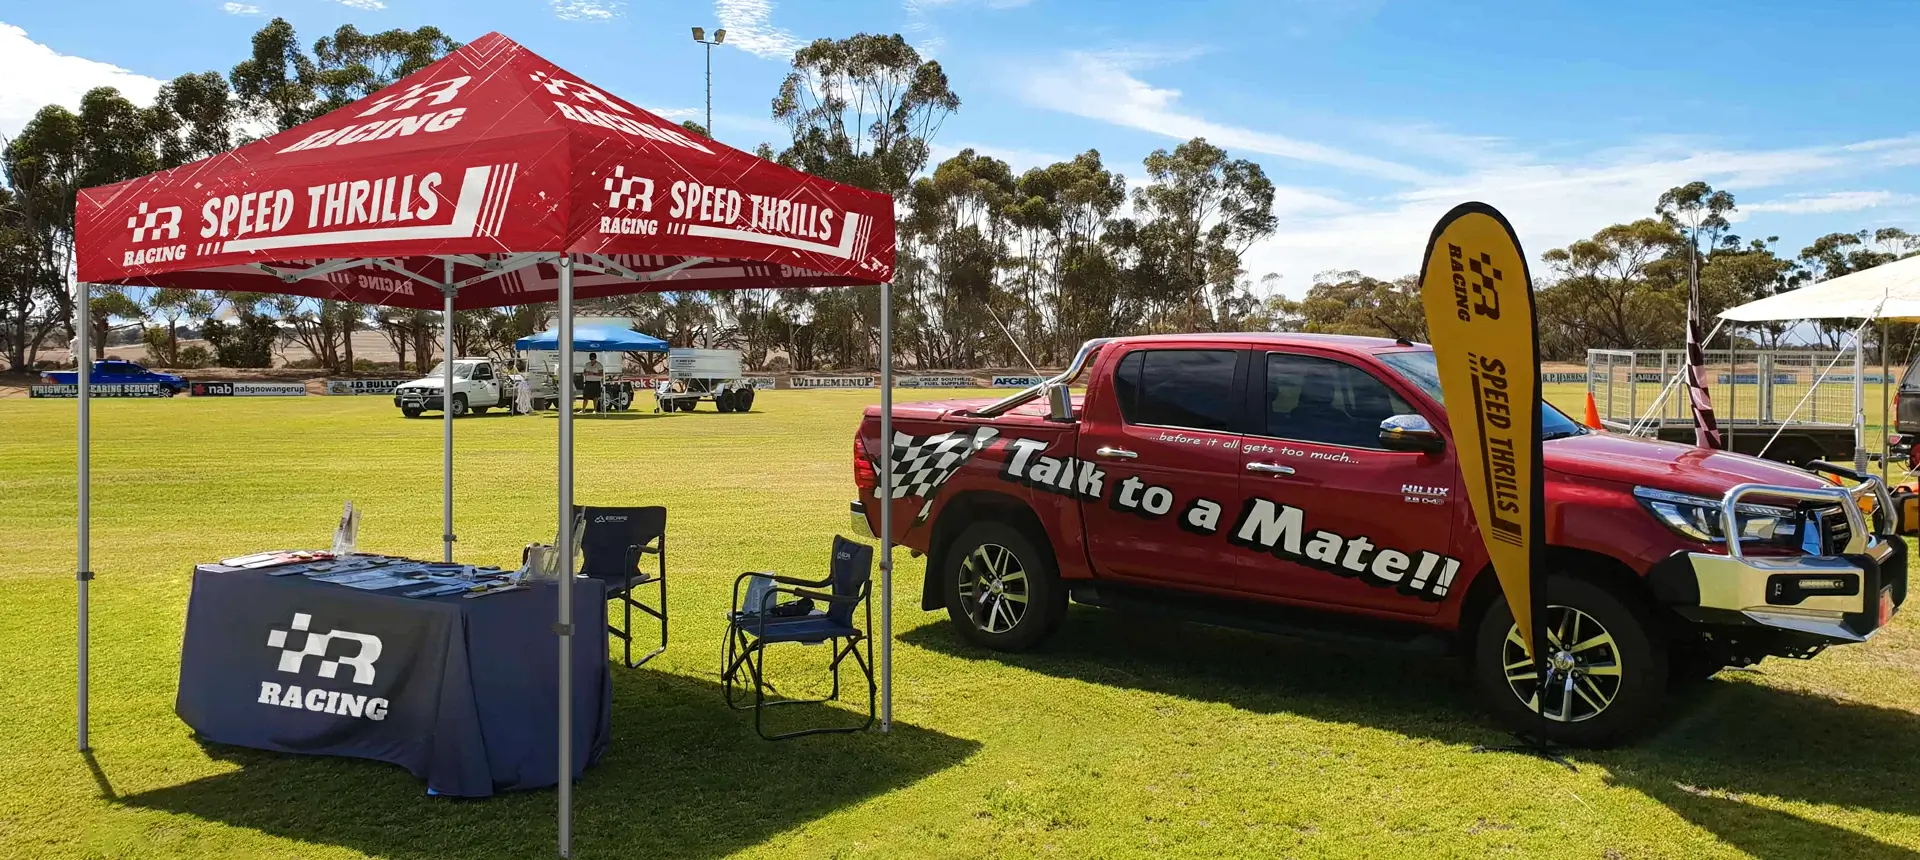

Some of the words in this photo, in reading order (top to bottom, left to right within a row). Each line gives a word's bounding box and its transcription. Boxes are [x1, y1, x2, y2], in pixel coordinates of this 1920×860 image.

[275, 107, 467, 154] RACING
[552, 101, 716, 155] RACING
[200, 188, 294, 240] SPEED
[307, 172, 443, 229] THRILLS
[599, 216, 659, 236] RACING
[669, 180, 741, 226] SPEED
[750, 194, 834, 241] THRILLS
[122, 244, 187, 267] RACING
[1448, 242, 1471, 323] RACING
[32, 385, 77, 396] TRIGWELL
[124, 384, 159, 395] SERVICE
[208, 384, 232, 394] nab
[234, 385, 305, 394] nabgnowangerup
[791, 377, 873, 387] WILLEMENUP
[1480, 355, 1512, 430] SPEED
[1206, 437, 1218, 447] it
[1222, 440, 1240, 449] all
[1243, 443, 1274, 454] gets
[1281, 446, 1304, 457] too
[1401, 484, 1449, 497] HILUX
[1489, 436, 1520, 515] THRILLS
[1007, 438, 1106, 498] Talk
[1117, 476, 1173, 515] to
[1186, 498, 1222, 531] a
[1237, 498, 1461, 597] Mate!!
[257, 681, 389, 721] RACING
